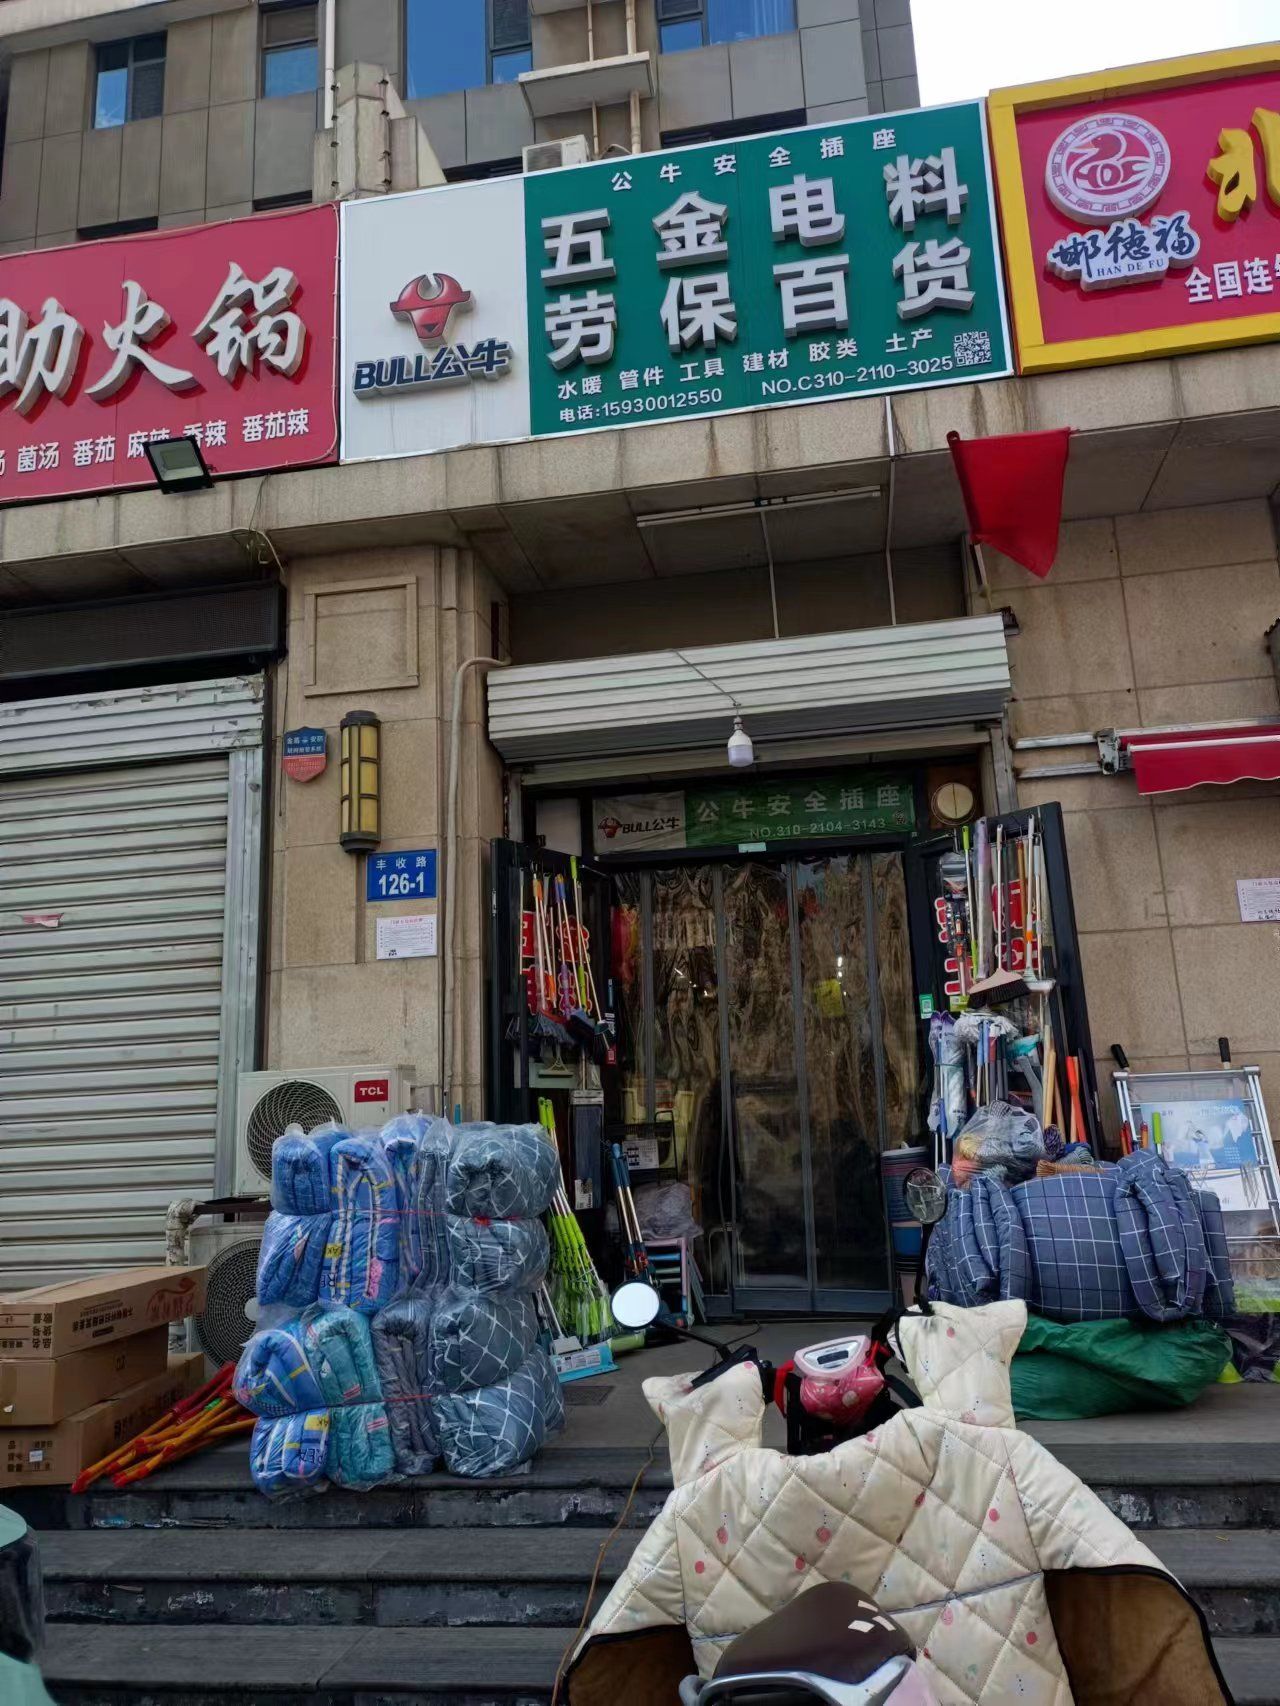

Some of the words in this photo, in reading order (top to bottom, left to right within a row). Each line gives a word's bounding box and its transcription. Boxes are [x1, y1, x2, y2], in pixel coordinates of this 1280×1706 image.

[611, 128, 897, 192] 公牛安全插座
[540, 146, 969, 286] 五金电料
[1097, 265, 1122, 277] HAN
[1128, 262, 1144, 272] DE
[1150, 258, 1164, 269] FU
[544, 236, 976, 371] 劳保百货
[557, 375, 603, 401] 水暖
[618, 369, 665, 391] 管件
[679, 357, 726, 382] 工具
[743, 347, 790, 372] 建材
[808, 339, 859, 362] 胶类
[885, 328, 934, 353] 土产
[558, 388, 723, 425] 电话:15930012550
[17, 441, 60, 473] 菌汤
[73, 436, 116, 467] 番茄
[242, 408, 309, 443] 番茄辣
[697, 784, 901, 823] 公牛安全插座
[376, 855, 427, 871] 丰收路
[378, 871, 425, 896] 126-1
[360, 1086, 384, 1096] TCL
